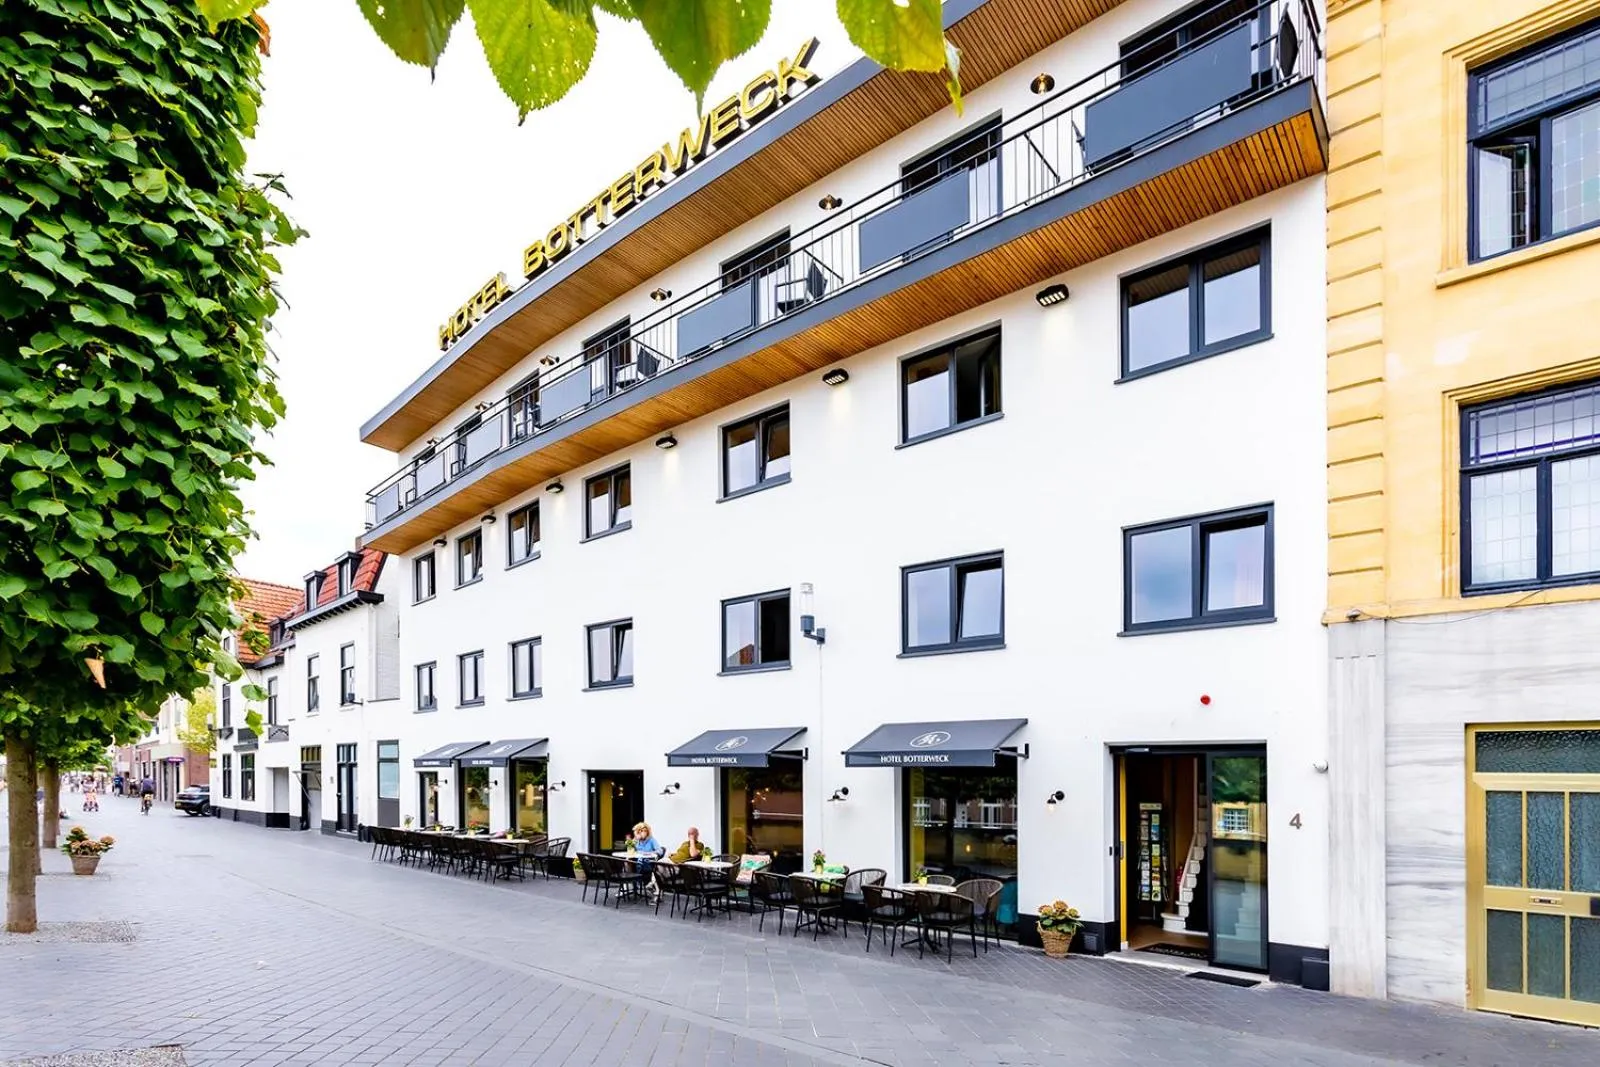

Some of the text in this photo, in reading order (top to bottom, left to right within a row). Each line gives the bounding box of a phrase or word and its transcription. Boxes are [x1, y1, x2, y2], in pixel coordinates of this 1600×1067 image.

[438, 36, 821, 351] HOTEL BOTTERWECK
[880, 754, 950, 763] HOTEL BOTTERWECK
[1289, 813, 1302, 830] 4
